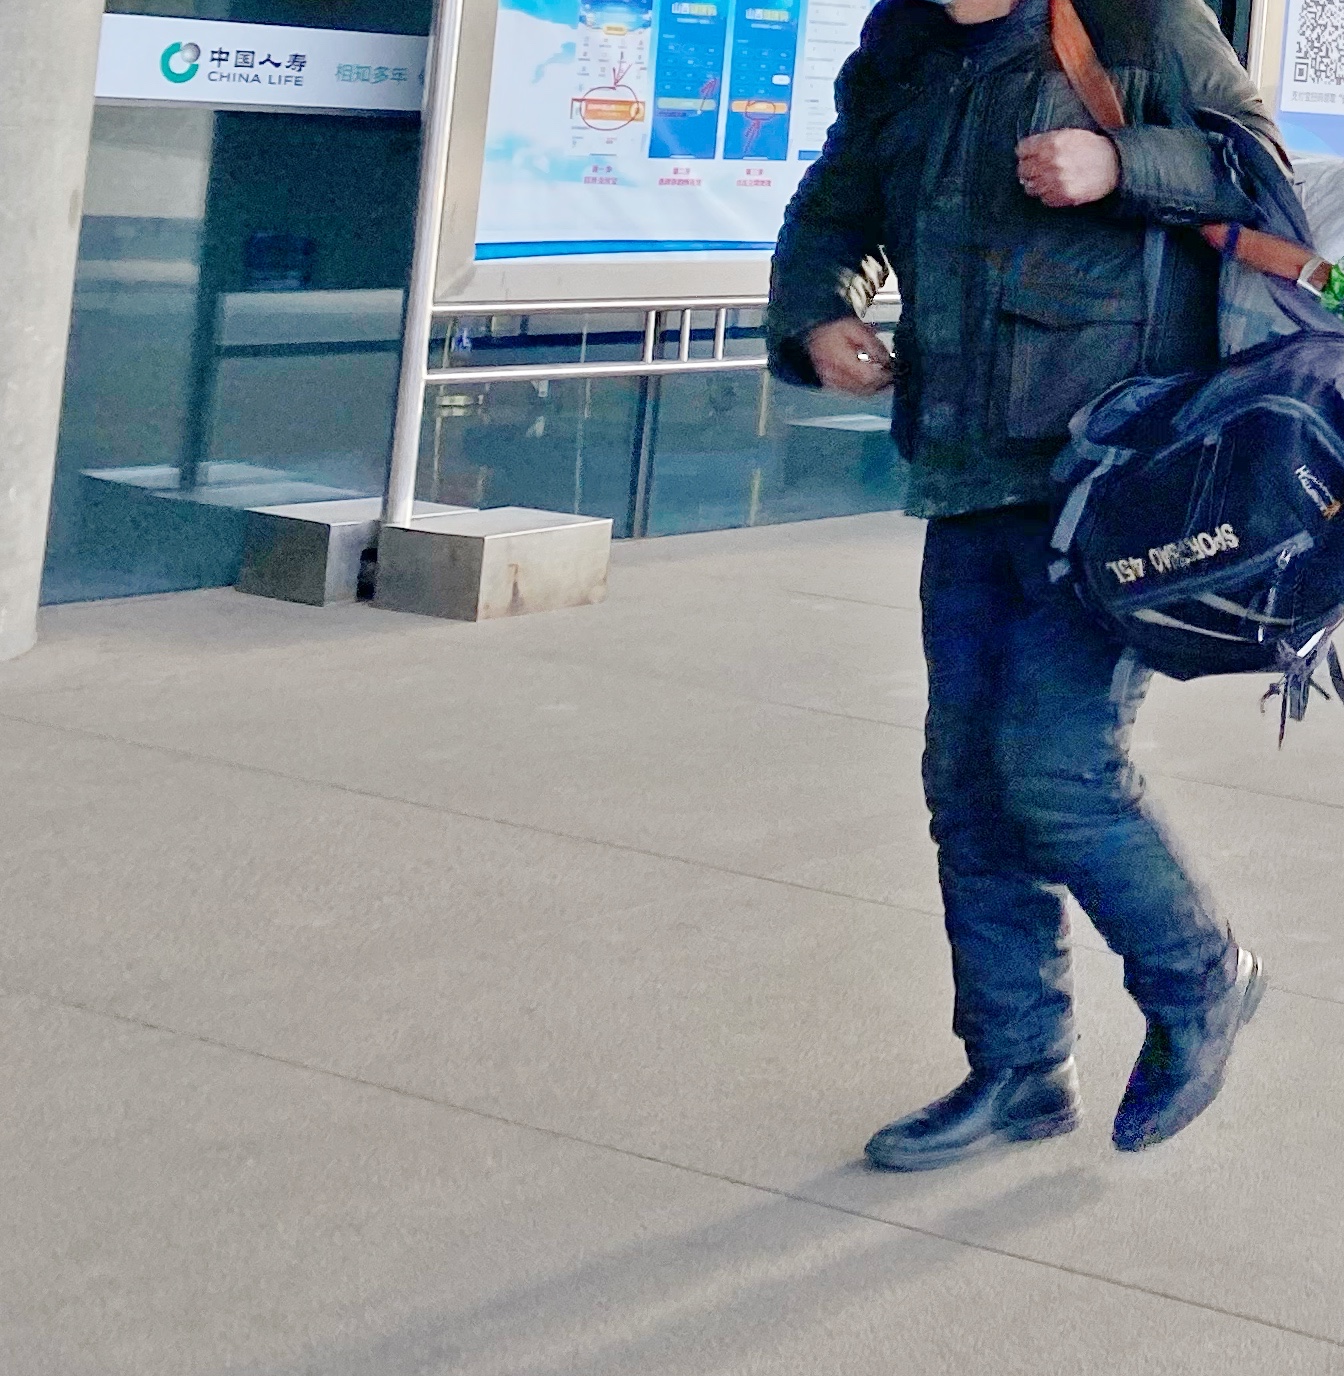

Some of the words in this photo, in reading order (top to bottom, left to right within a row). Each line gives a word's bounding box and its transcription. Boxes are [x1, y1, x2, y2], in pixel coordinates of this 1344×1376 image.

[208, 71, 261, 84] CHINA
[268, 75, 304, 86] LIFE
[209, 47, 306, 72] 中国人寿
[335, 63, 408, 85] 相知多年
